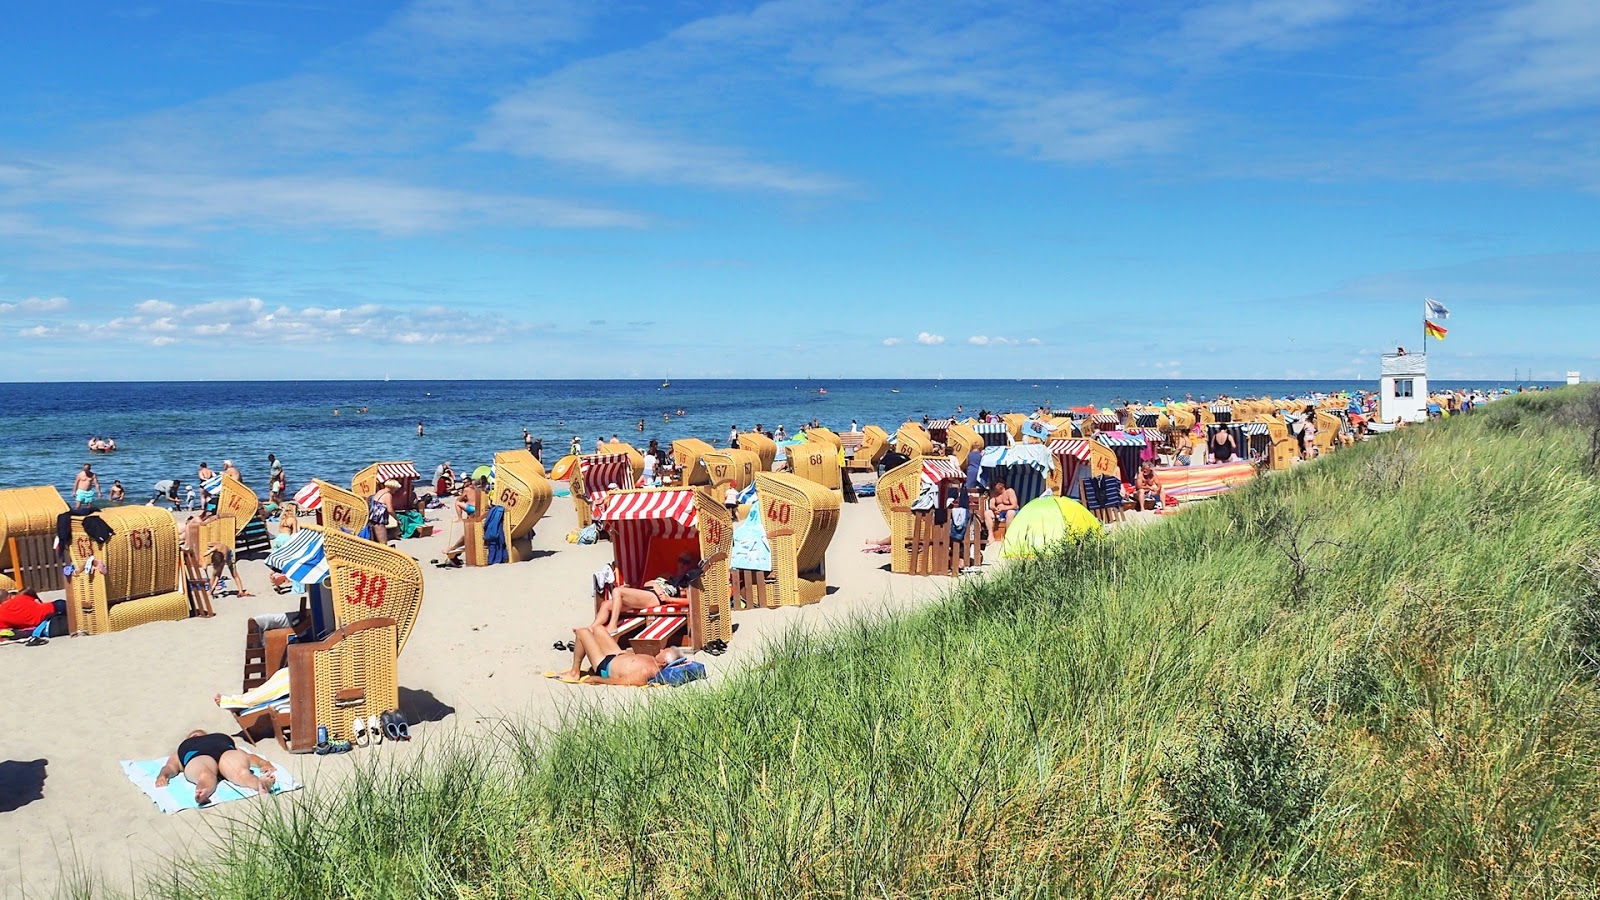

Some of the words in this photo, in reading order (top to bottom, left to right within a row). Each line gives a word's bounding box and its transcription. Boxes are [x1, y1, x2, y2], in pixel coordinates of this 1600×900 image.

[901, 444, 912, 456] 69
[952, 441, 962, 452] 70
[810, 454, 822, 465] 68
[1096, 458, 1108, 471] 43
[715, 465, 727, 477] 67
[500, 488, 518, 507] 65
[890, 482, 909, 503] 41
[332, 505, 351, 524] 64
[767, 499, 790, 525] 40
[131, 529, 152, 550] 63
[706, 517, 721, 543] 39
[77, 537, 94, 557] 63
[346, 571, 387, 608] 38
